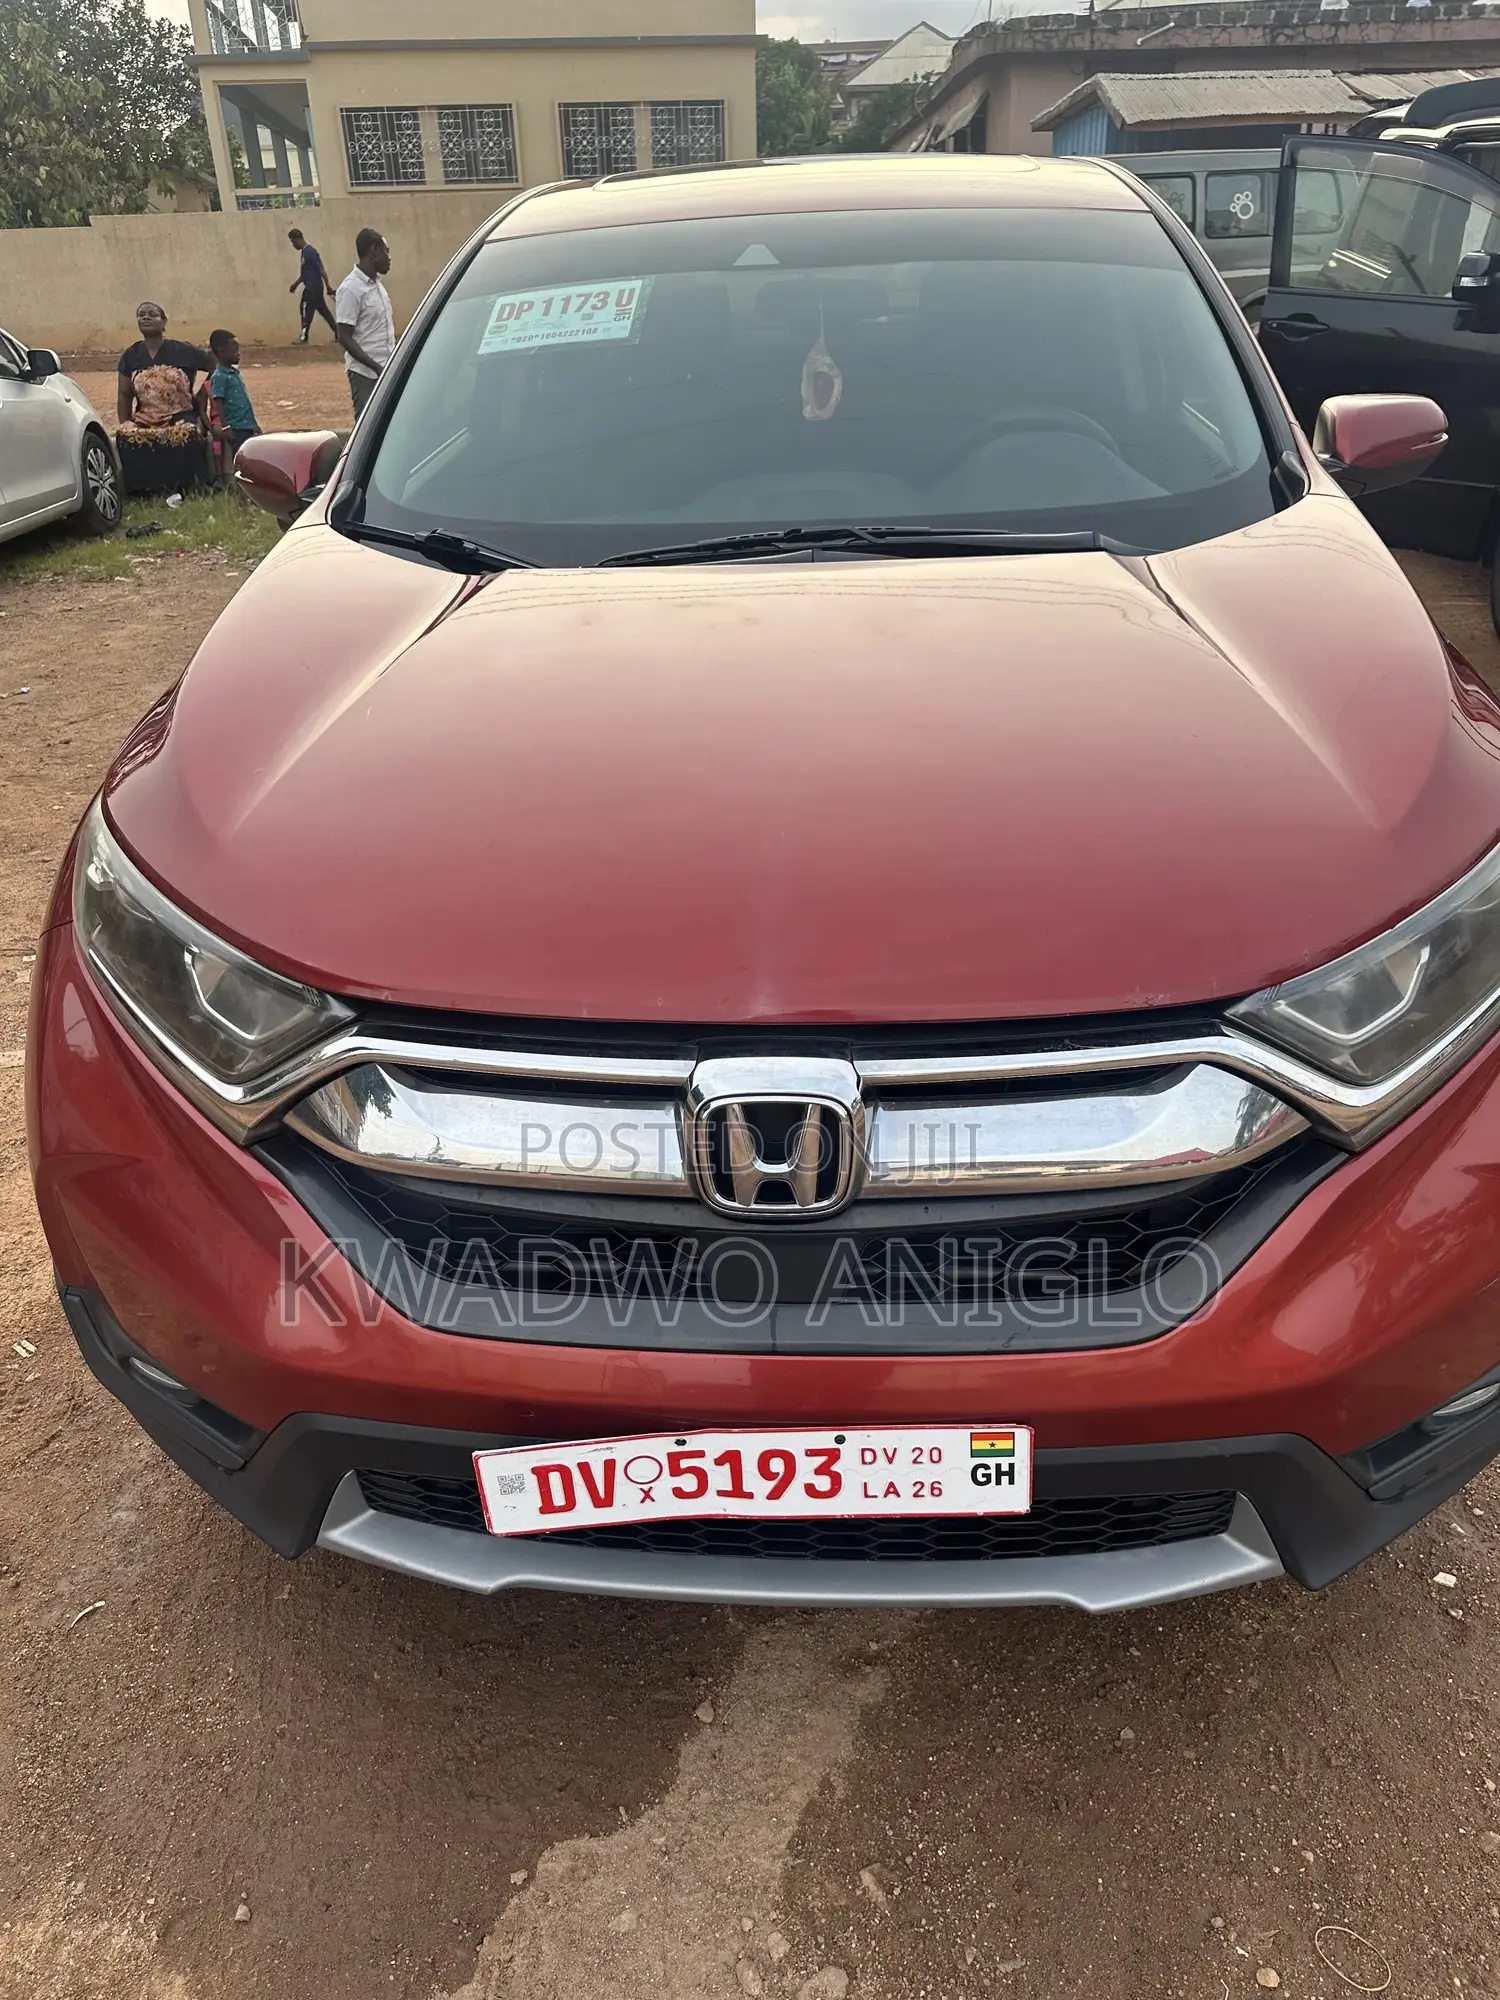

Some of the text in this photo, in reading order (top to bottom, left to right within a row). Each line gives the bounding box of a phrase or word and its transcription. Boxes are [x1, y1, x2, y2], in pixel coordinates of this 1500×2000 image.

[495, 288, 636, 322] DP 1173 U
[613, 314, 631, 322] GH
[860, 1446, 943, 1465] DV 20
[531, 1458, 616, 1514] DV
[666, 1447, 843, 1500] 5193
[970, 1462, 1016, 1487] GH
[863, 1480, 943, 1499] LA 26
